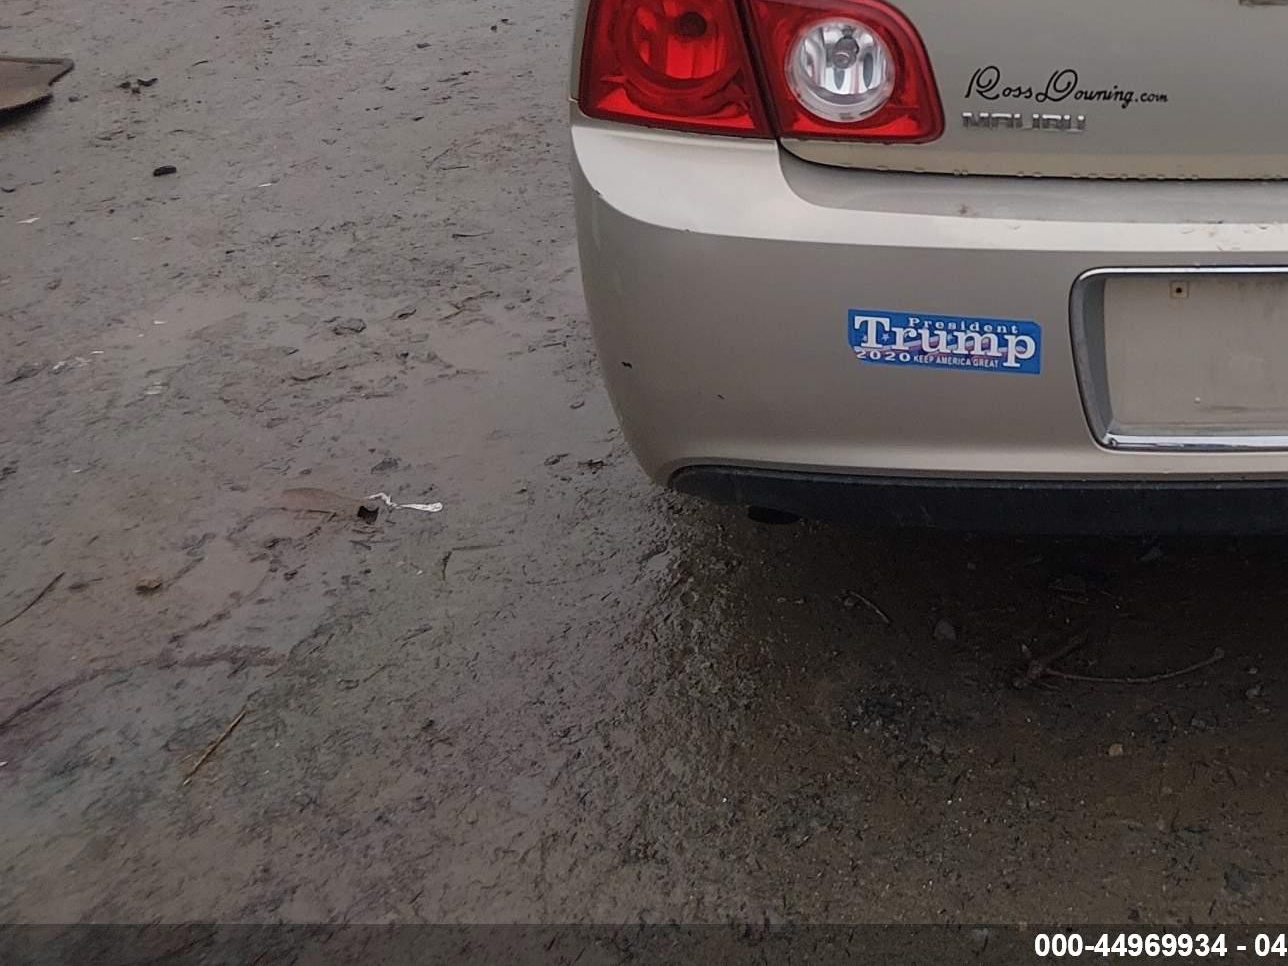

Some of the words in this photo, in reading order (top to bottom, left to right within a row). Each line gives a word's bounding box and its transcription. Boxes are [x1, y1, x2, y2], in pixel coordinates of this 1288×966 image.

[962, 112, 1086, 134] MALIBU
[908, 317, 1019, 334] President
[854, 315, 1036, 368] Trump
[856, 348, 911, 363] 2020
[913, 354, 934, 364] KEEP
[935, 355, 971, 367] AMERICA
[972, 357, 999, 368] GREAT
